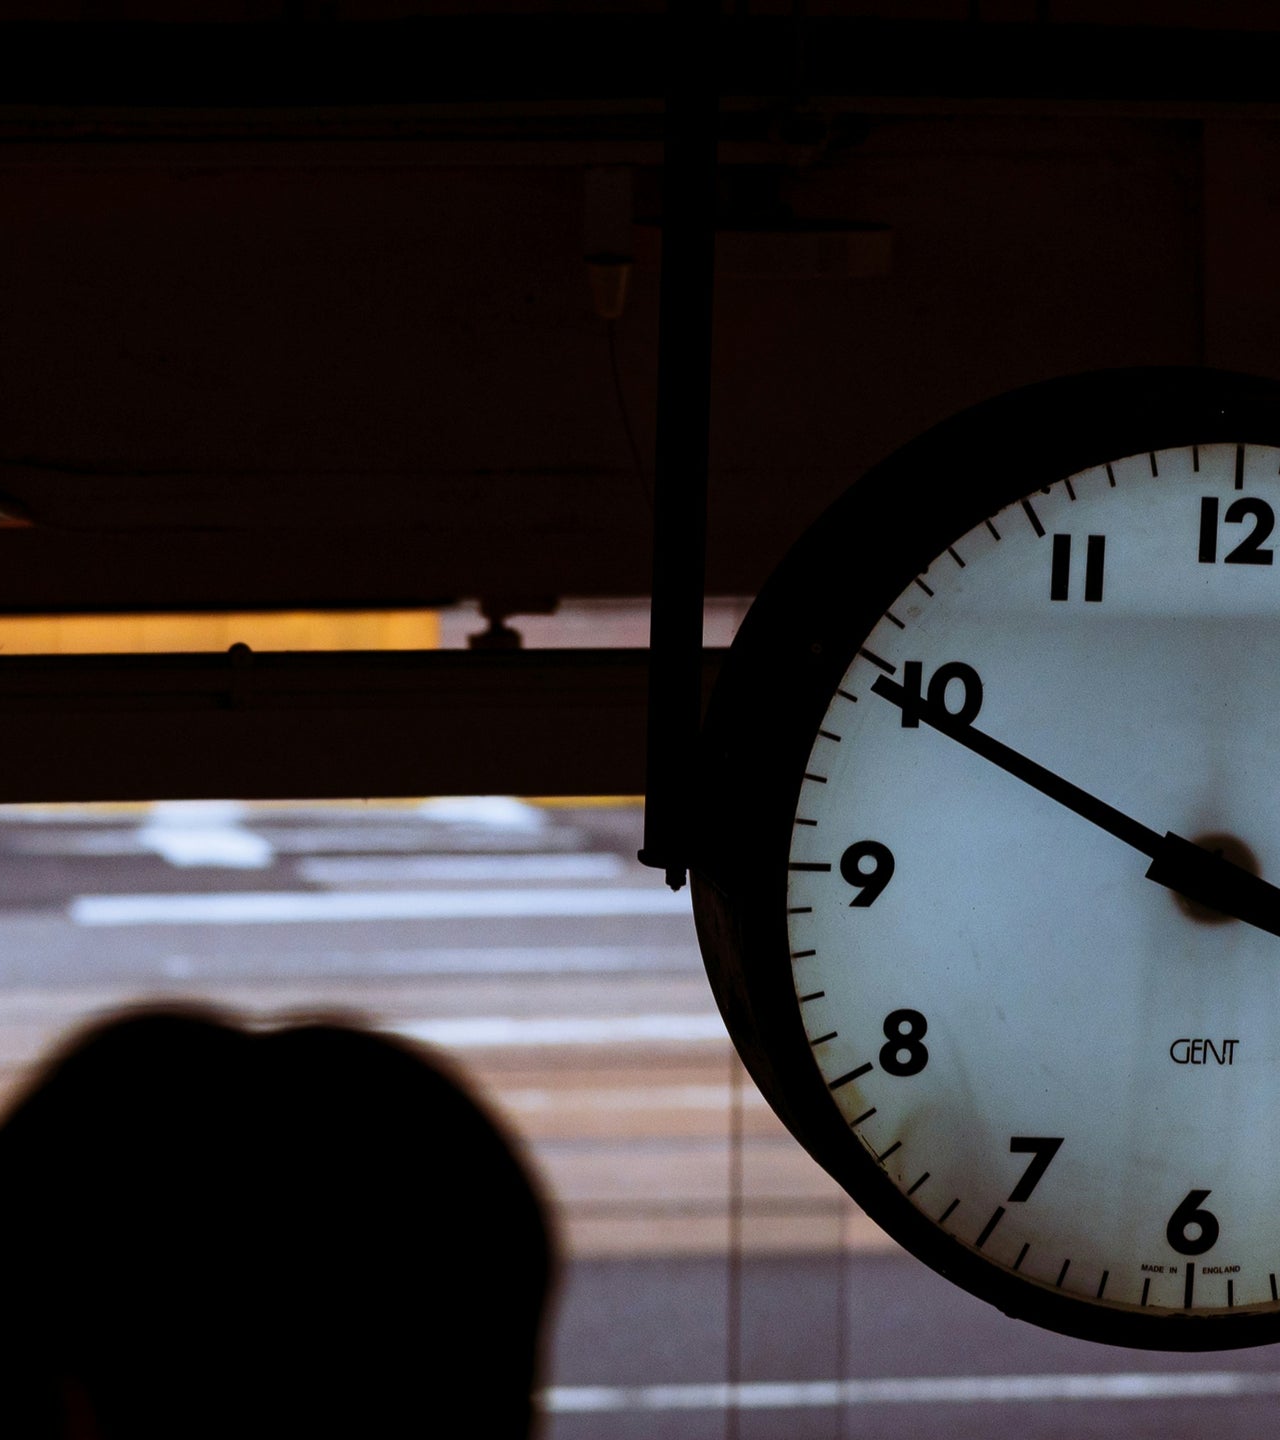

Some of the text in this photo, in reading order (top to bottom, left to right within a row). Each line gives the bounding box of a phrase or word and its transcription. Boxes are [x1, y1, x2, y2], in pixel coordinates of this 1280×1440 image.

[1198, 496, 1275, 566] 12
[1050, 533, 1106, 603] 11
[901, 660, 984, 731] 10
[839, 840, 895, 908] 9
[878, 1008, 929, 1078] 8
[1169, 1037, 1240, 1065] GENT
[1006, 1136, 1065, 1204] 7
[1165, 1189, 1220, 1257] 6
[1141, 1264, 1164, 1273] MADE
[1202, 1265, 1241, 1275] ENGLAND
